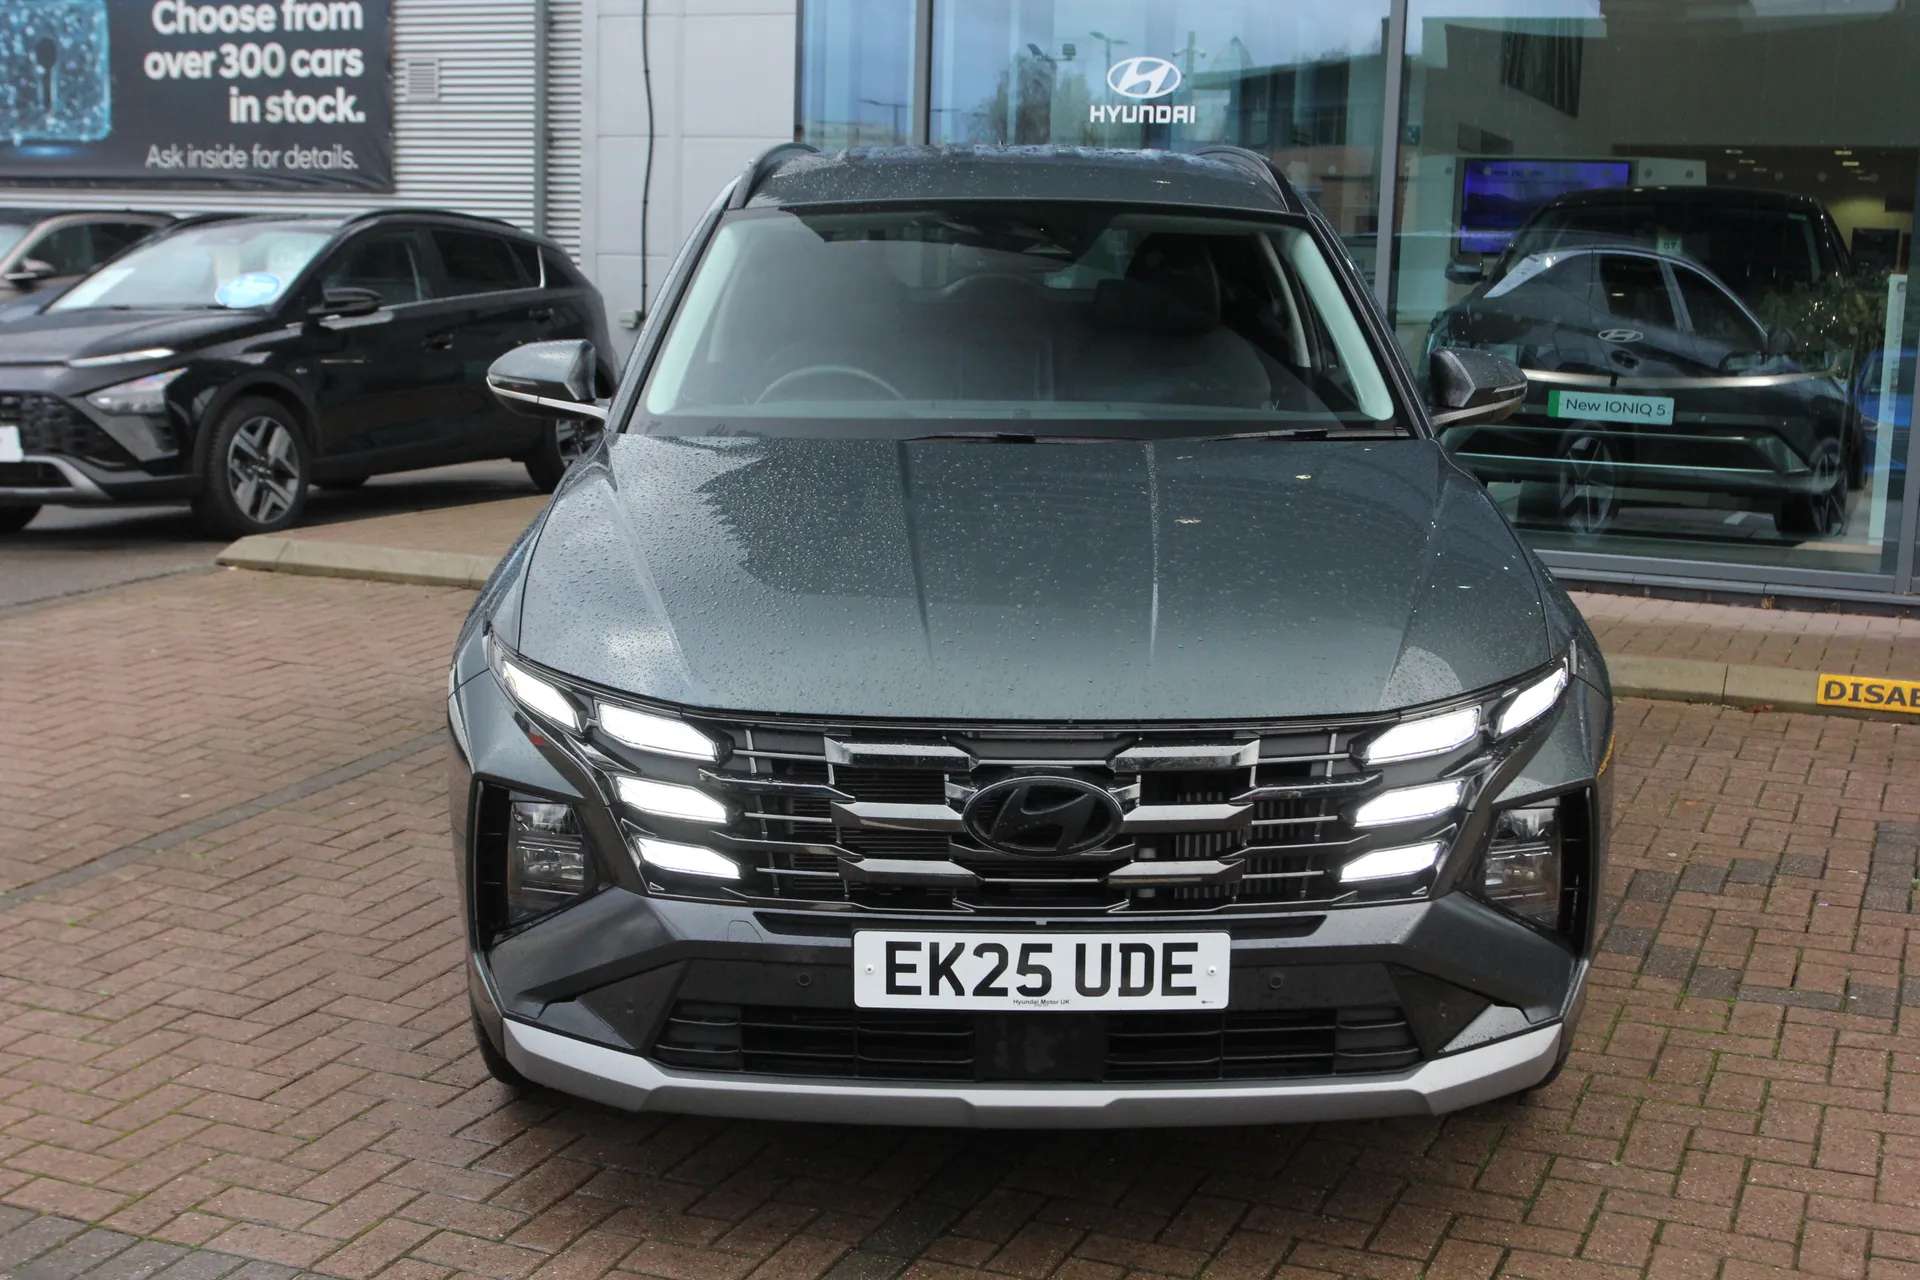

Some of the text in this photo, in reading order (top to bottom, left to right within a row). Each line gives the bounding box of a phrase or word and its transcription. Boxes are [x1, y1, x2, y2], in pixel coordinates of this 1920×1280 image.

[152, 0, 363, 34] Choose from
[144, 42, 365, 79] over 300 cars
[229, 86, 366, 123] in stock.
[1089, 105, 1196, 123] HYUNDAI
[145, 144, 359, 169] Ask inside for details.
[1566, 399, 1666, 416] New IONIQ 5
[886, 941, 1198, 997] EK25 UDE
